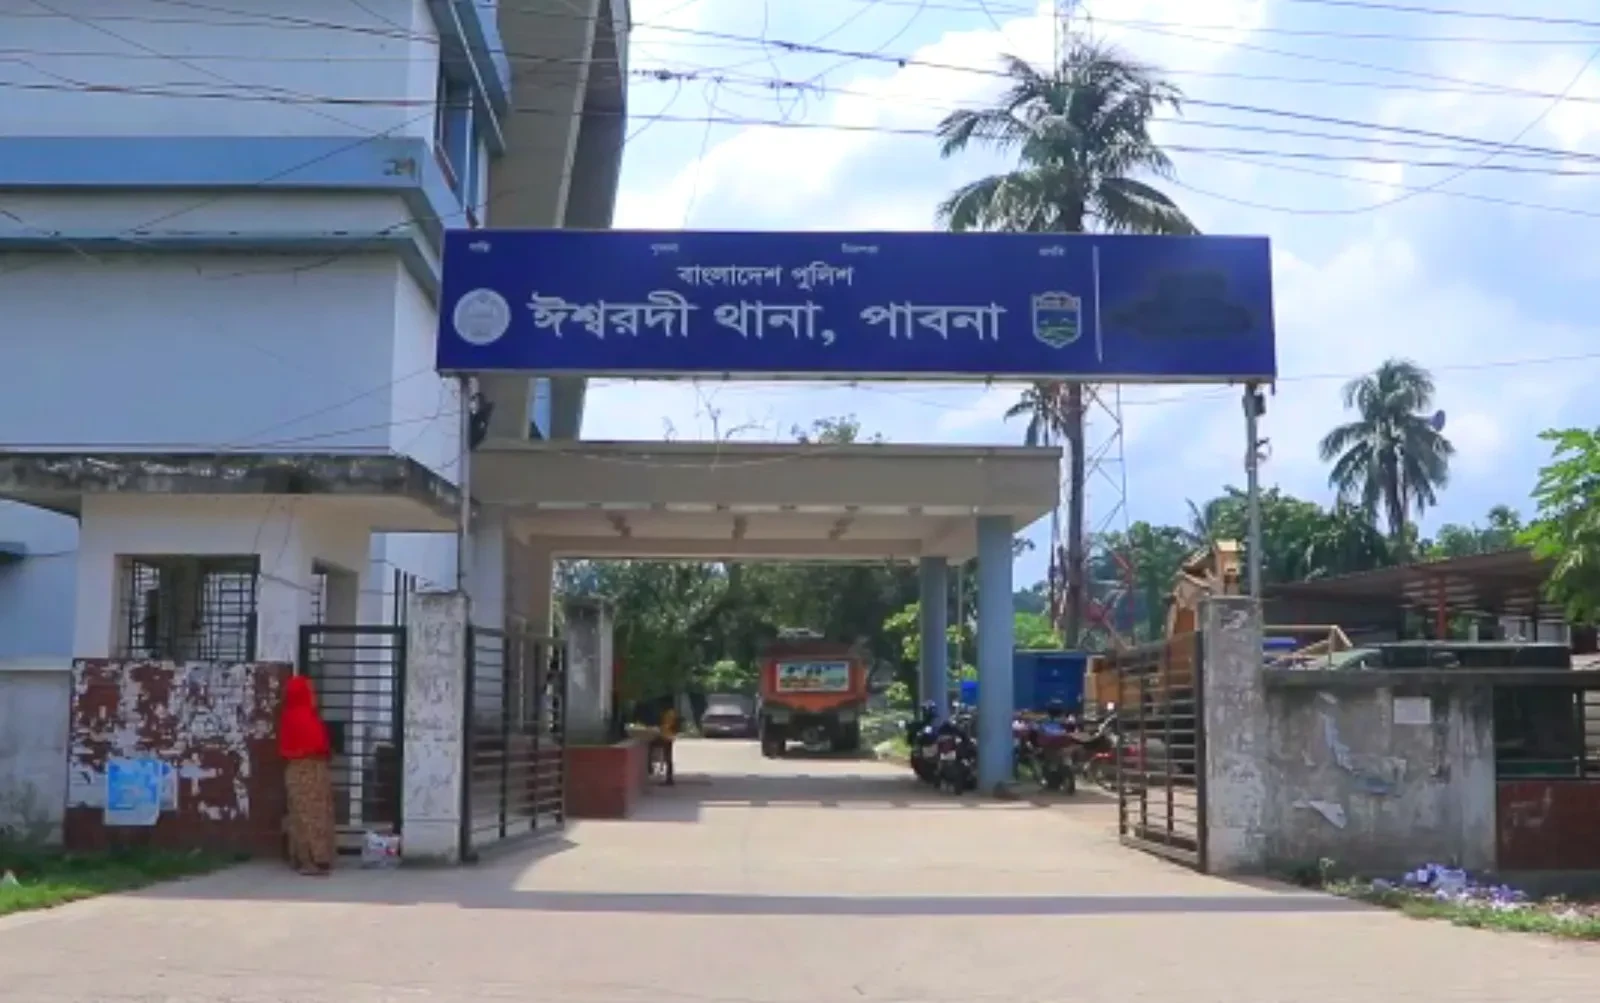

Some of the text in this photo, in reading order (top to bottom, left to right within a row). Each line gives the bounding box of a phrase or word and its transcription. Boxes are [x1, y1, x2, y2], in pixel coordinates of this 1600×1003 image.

[677, 261, 853, 291] বাংলাদেশ পুলিশ
[526, 290, 1007, 346] ঈশ্বরদী থানা, পাবনা
